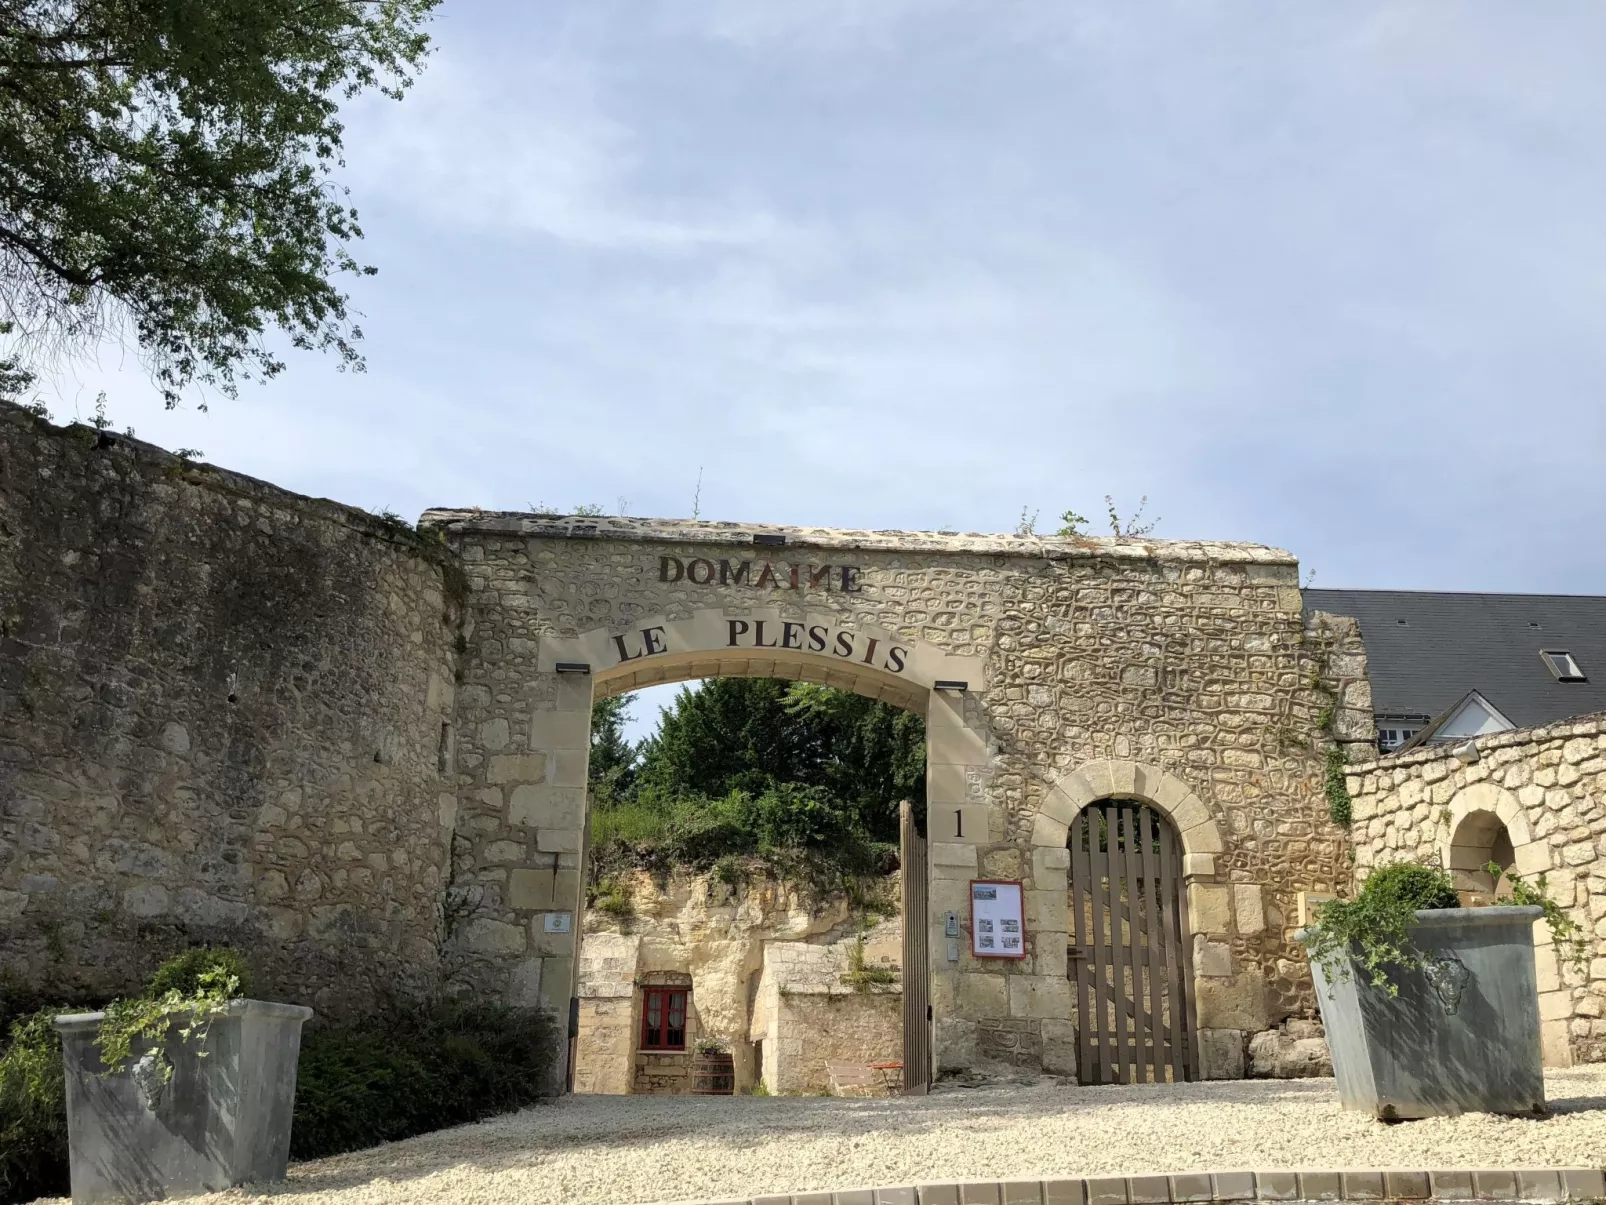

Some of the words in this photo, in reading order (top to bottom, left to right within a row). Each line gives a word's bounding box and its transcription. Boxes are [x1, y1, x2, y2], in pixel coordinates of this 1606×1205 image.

[659, 556, 863, 592] DOMAINE
[612, 625, 668, 663] LE
[725, 619, 908, 673] PLESSIS
[953, 809, 965, 838] 1
